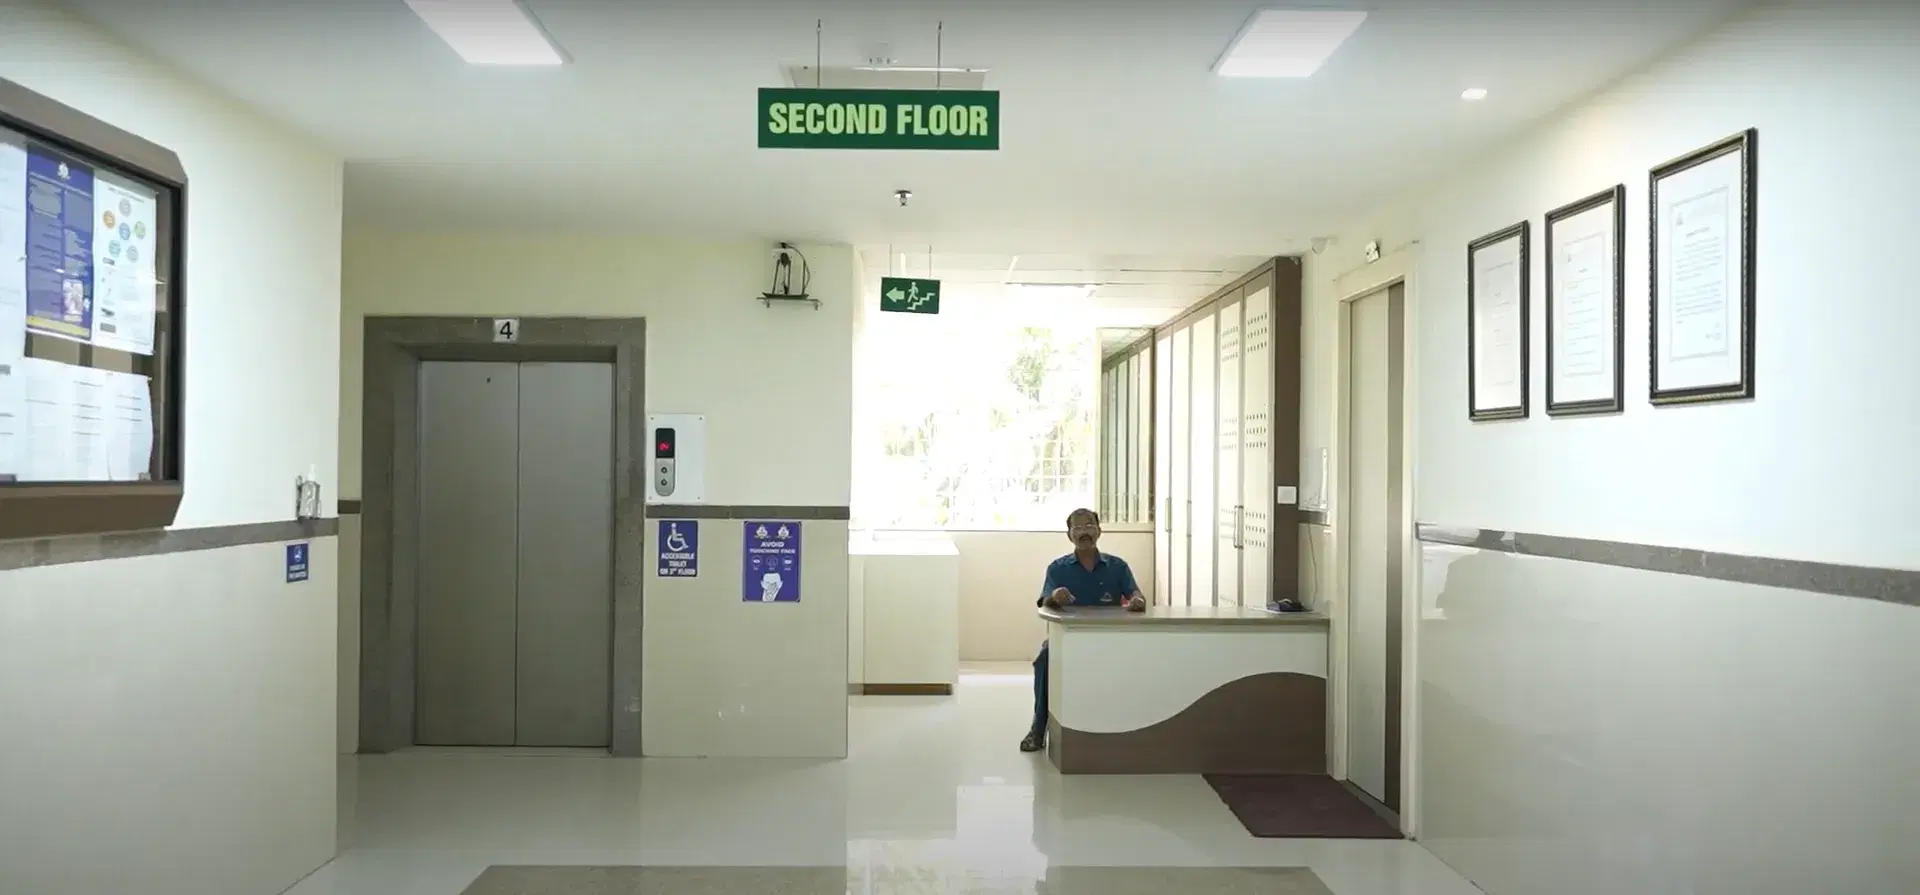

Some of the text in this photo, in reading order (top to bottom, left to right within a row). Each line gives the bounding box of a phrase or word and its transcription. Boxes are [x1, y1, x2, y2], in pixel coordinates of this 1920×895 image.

[768, 103, 988, 136] SECOND FLOOR
[500, 321, 513, 339] 4
[661, 552, 695, 560] ACCESSIBLE
